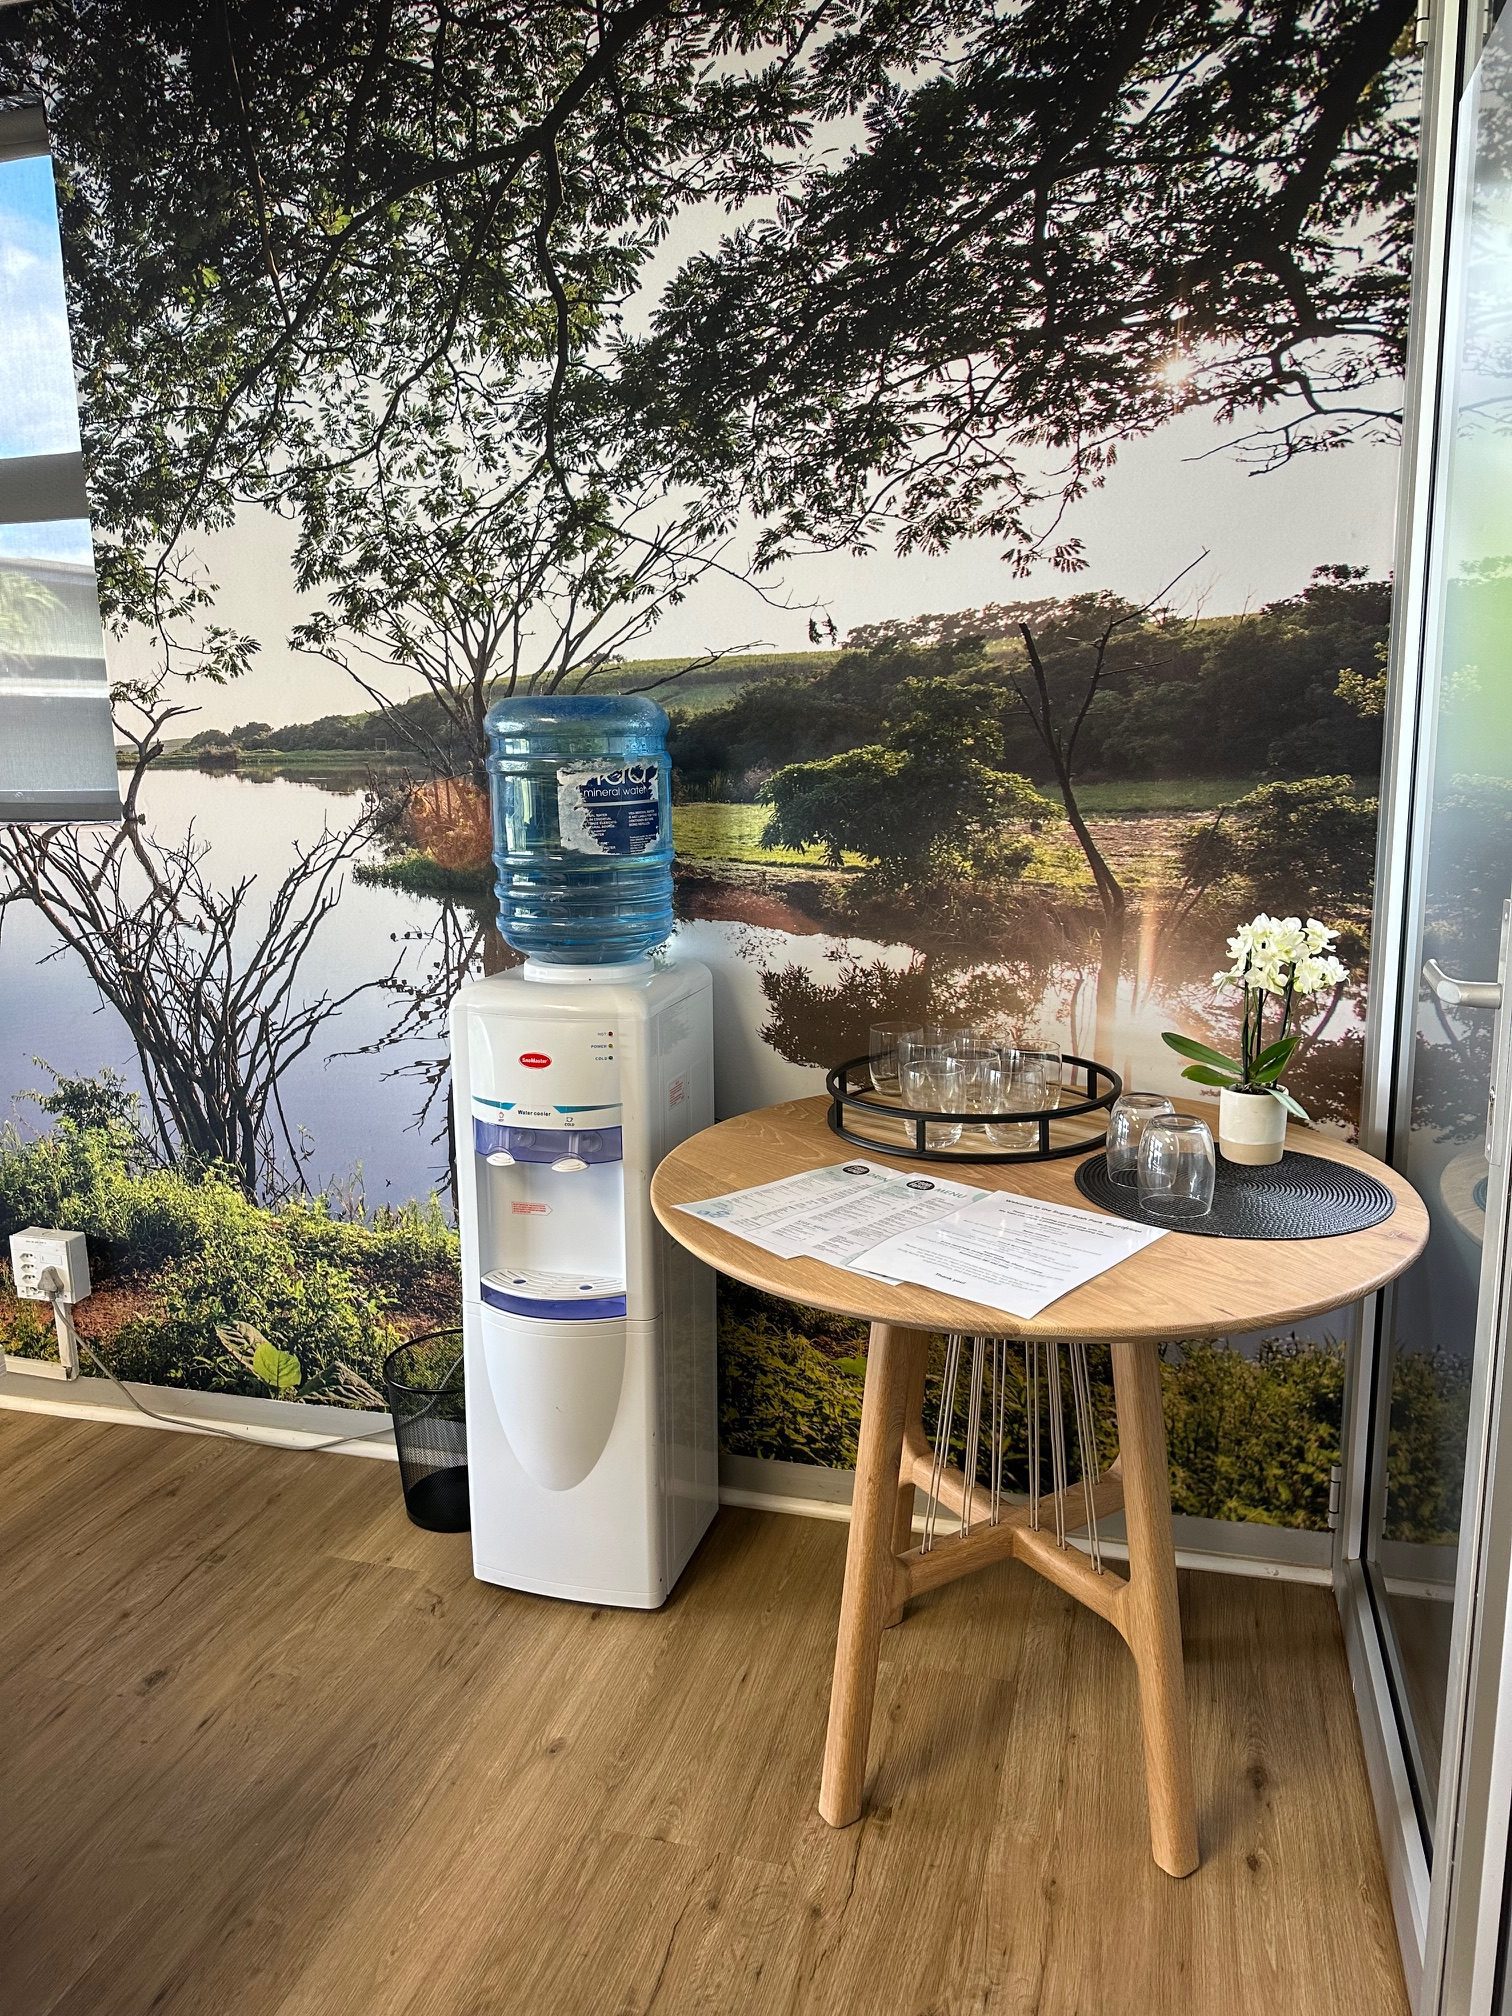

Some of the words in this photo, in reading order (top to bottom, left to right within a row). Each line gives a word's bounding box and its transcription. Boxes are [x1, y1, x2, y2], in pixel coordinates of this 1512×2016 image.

[583, 787, 620, 798] mineral
[623, 786, 647, 796] water
[934, 1187, 967, 1199] MENU
